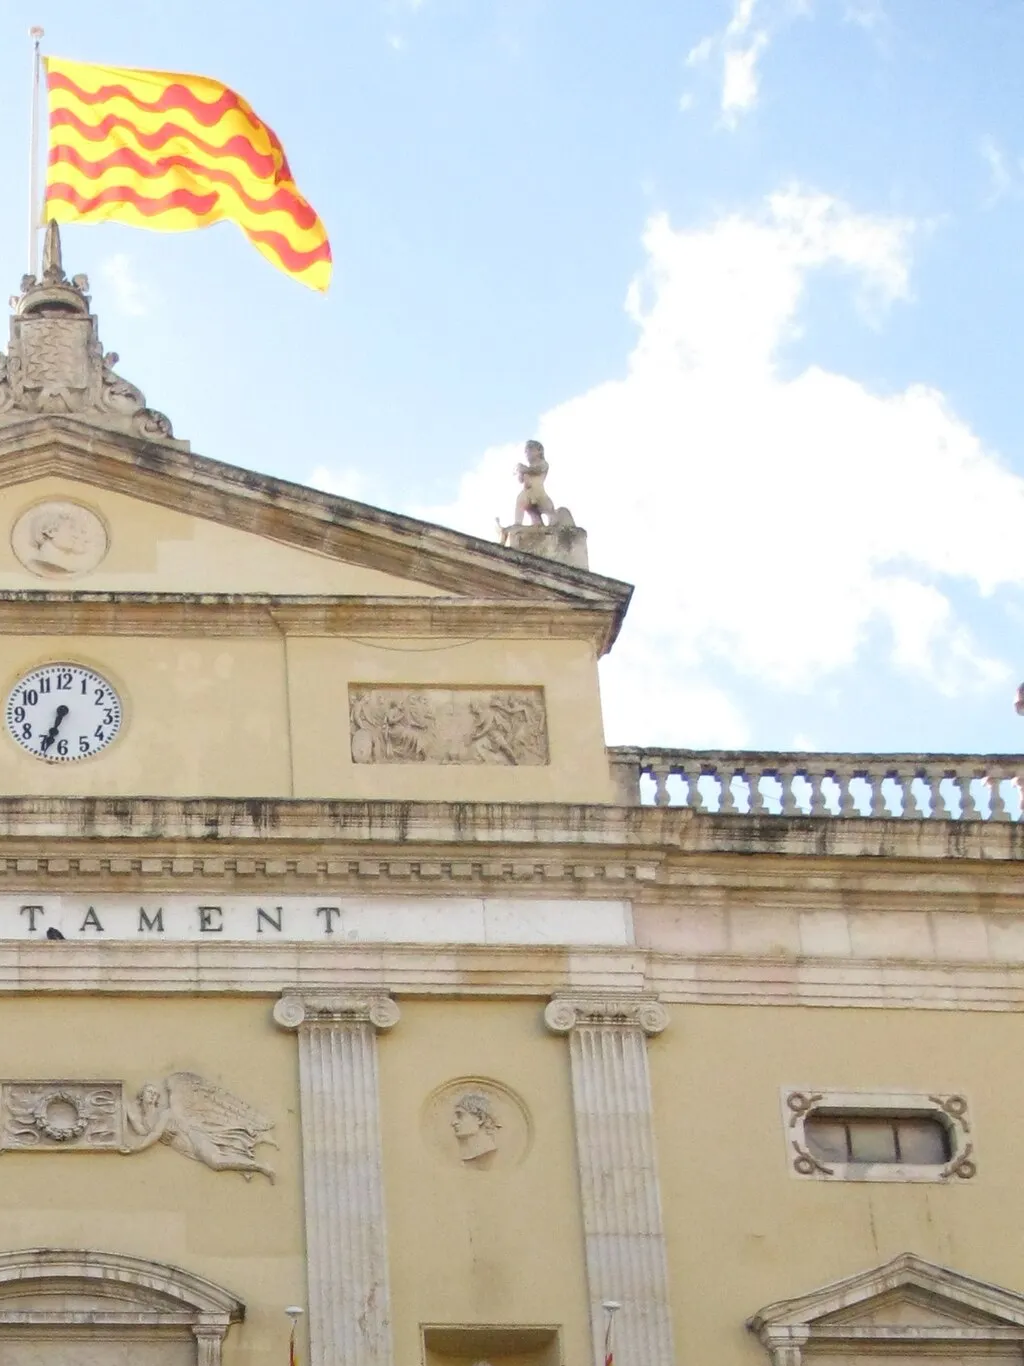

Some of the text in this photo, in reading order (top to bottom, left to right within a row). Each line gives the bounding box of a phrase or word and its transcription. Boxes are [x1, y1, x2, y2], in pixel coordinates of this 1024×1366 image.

[38, 677, 51, 693] 11
[56, 673, 73, 690] 12
[81, 678, 87, 695] 1
[22, 689, 38, 706] 10
[94, 688, 104, 706] 2
[14, 706, 25, 723] 9
[102, 708, 114, 725] 3
[22, 723, 32, 740] 8
[94, 725, 104, 741] 4
[57, 739, 68, 755] 6
[79, 736, 90, 752] 5
